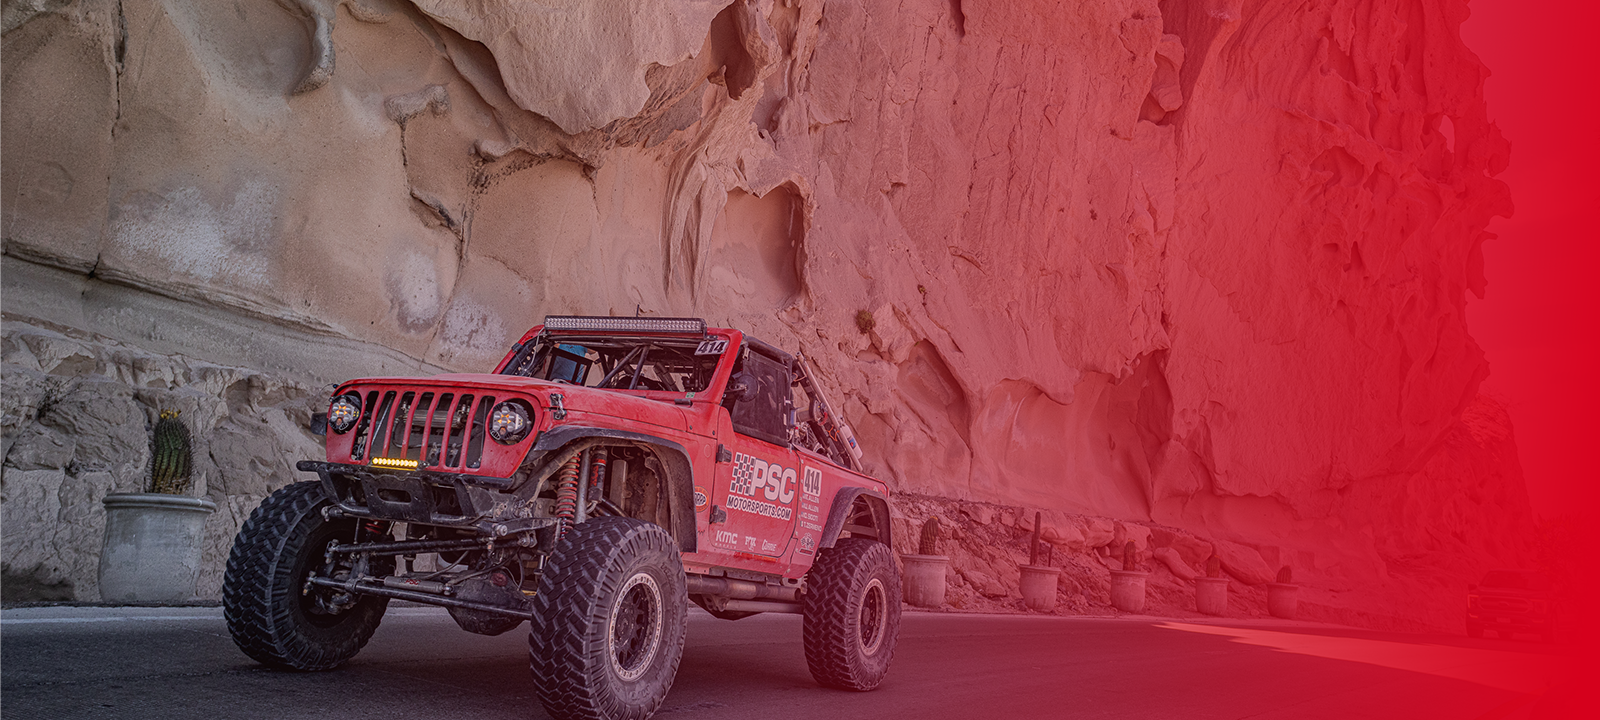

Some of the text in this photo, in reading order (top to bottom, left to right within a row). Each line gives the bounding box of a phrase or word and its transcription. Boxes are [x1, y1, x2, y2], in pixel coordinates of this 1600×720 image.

[698, 341, 725, 353] 414
[748, 459, 797, 504] PSC
[804, 469, 820, 494] 414
[726, 494, 791, 520] MOTORSPORTS.COM
